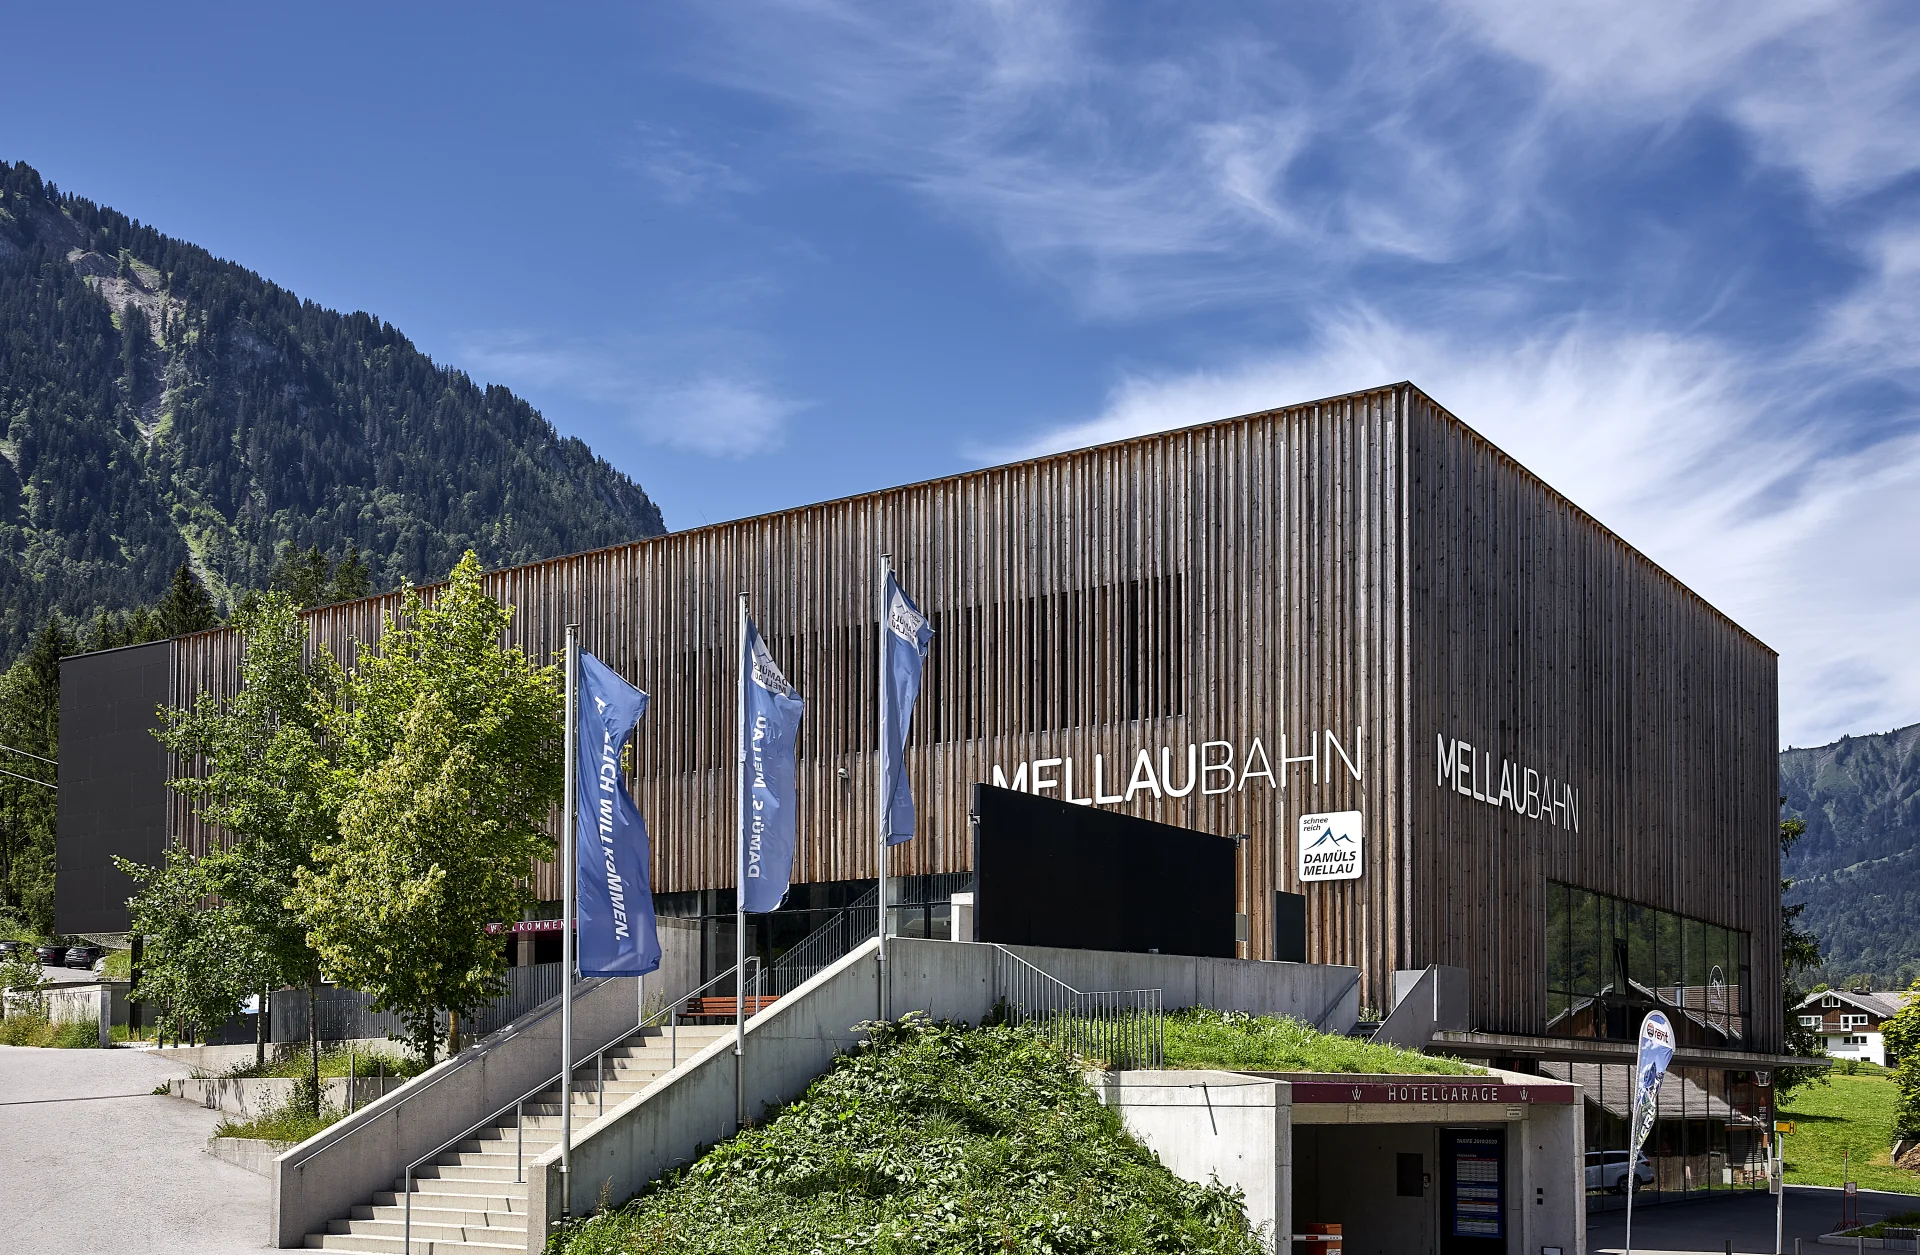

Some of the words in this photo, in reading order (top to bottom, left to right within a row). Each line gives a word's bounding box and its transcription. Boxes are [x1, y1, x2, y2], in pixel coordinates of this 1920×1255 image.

[1437, 733, 1578, 834] MELLAUBAHN
[1303, 817, 1328, 825] schnee
[1303, 849, 1356, 864] DAMÜLS
[600, 799, 630, 941] WILLKOMMEN.
[1303, 863, 1354, 876] MELLAU
[490, 921, 565, 933] WLKOMMEN
[1655, 1030, 1668, 1044] rent
[1388, 1087, 1498, 1101] HOTELGARAGE
[1790, 1123, 1794, 1133] H
